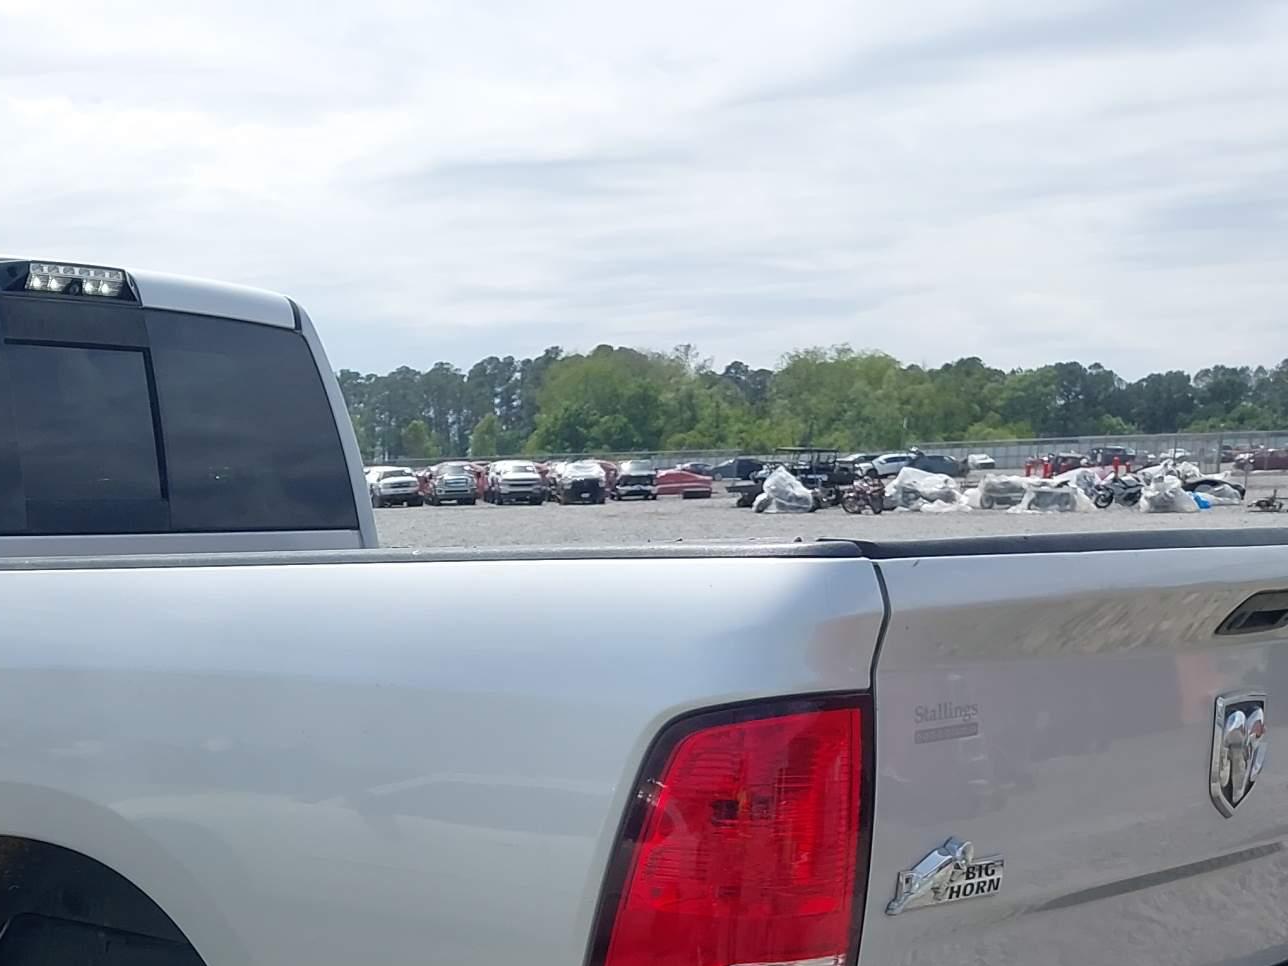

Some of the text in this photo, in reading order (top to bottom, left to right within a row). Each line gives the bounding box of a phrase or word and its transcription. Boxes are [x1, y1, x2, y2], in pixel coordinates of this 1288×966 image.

[913, 701, 979, 723] Stallings
[965, 862, 996, 881] BIG
[948, 877, 1001, 899] HORN
